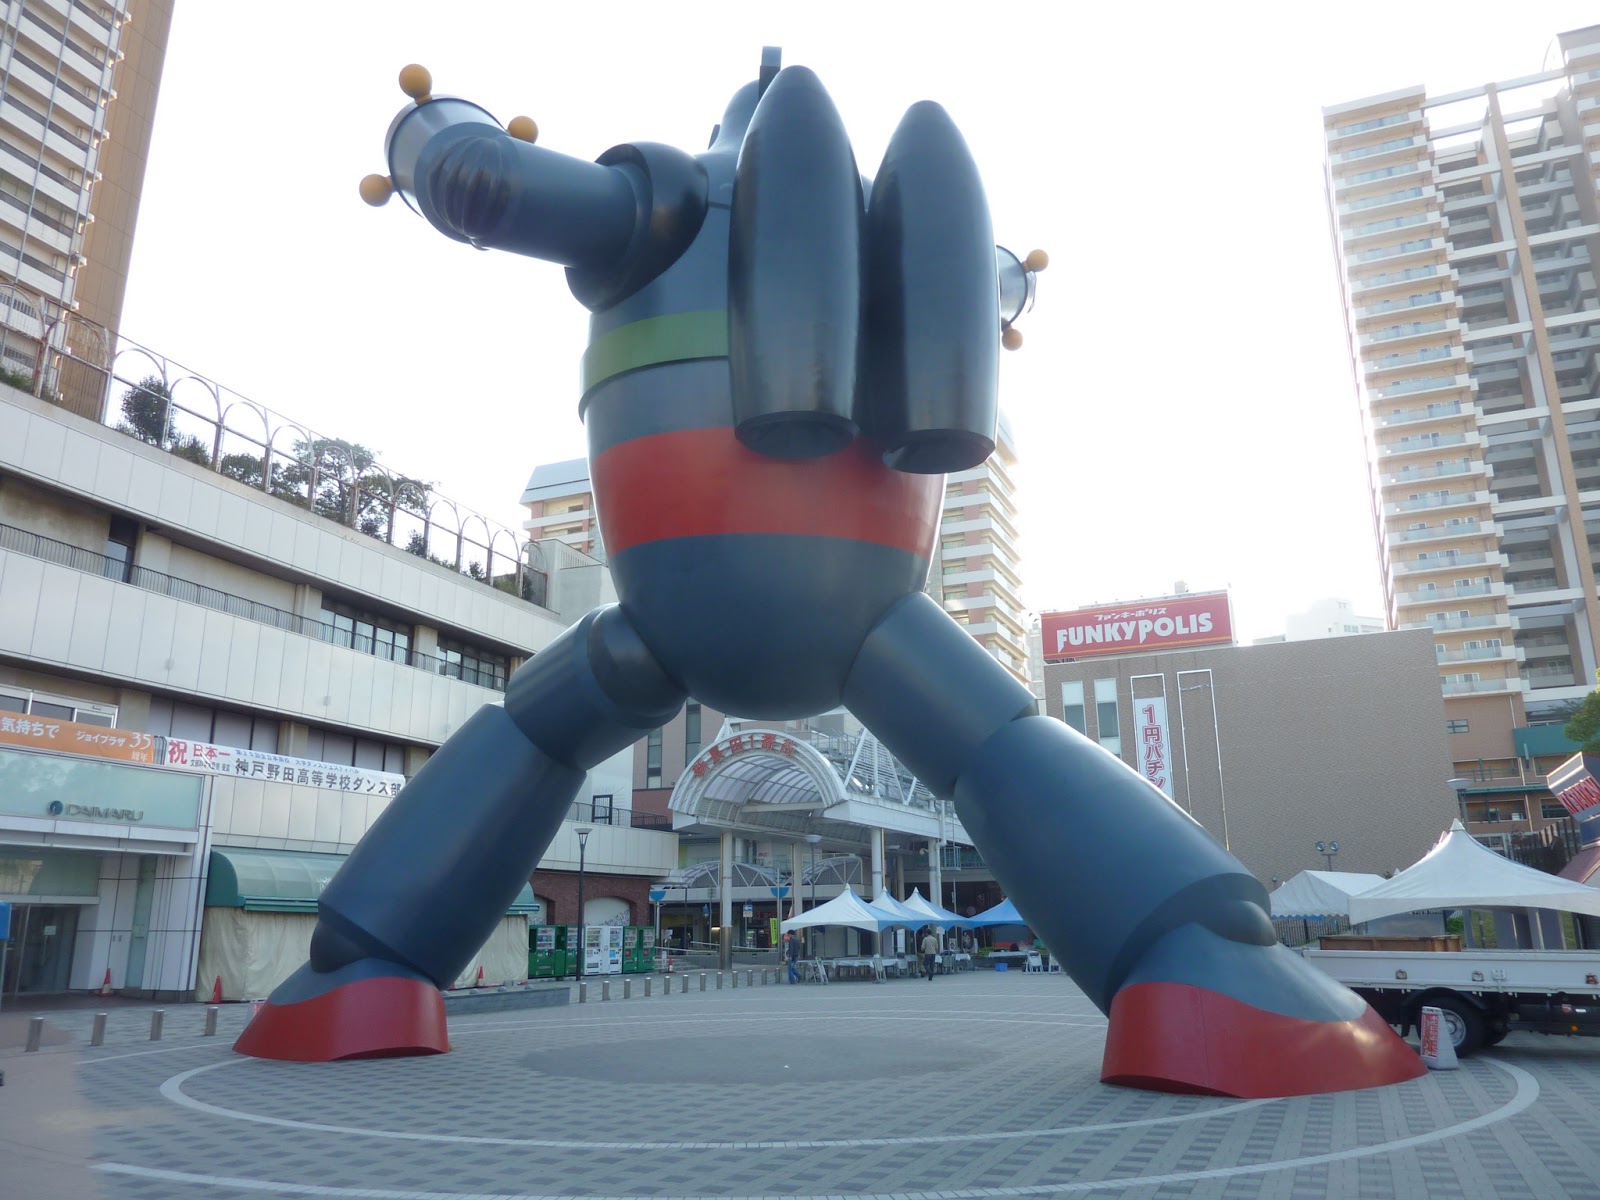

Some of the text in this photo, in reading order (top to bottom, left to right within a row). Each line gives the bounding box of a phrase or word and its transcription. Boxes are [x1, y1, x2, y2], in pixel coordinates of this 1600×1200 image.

[1094, 607, 1167, 621] ファンキーポリス
[1, 716, 60, 739] 気持ちで
[129, 731, 151, 750] 35
[168, 740, 231, 765] 祝 日本一
[235, 757, 401, 797] 神戸野田高等学校ダンス部
[67, 803, 144, 821] DAIMARU
